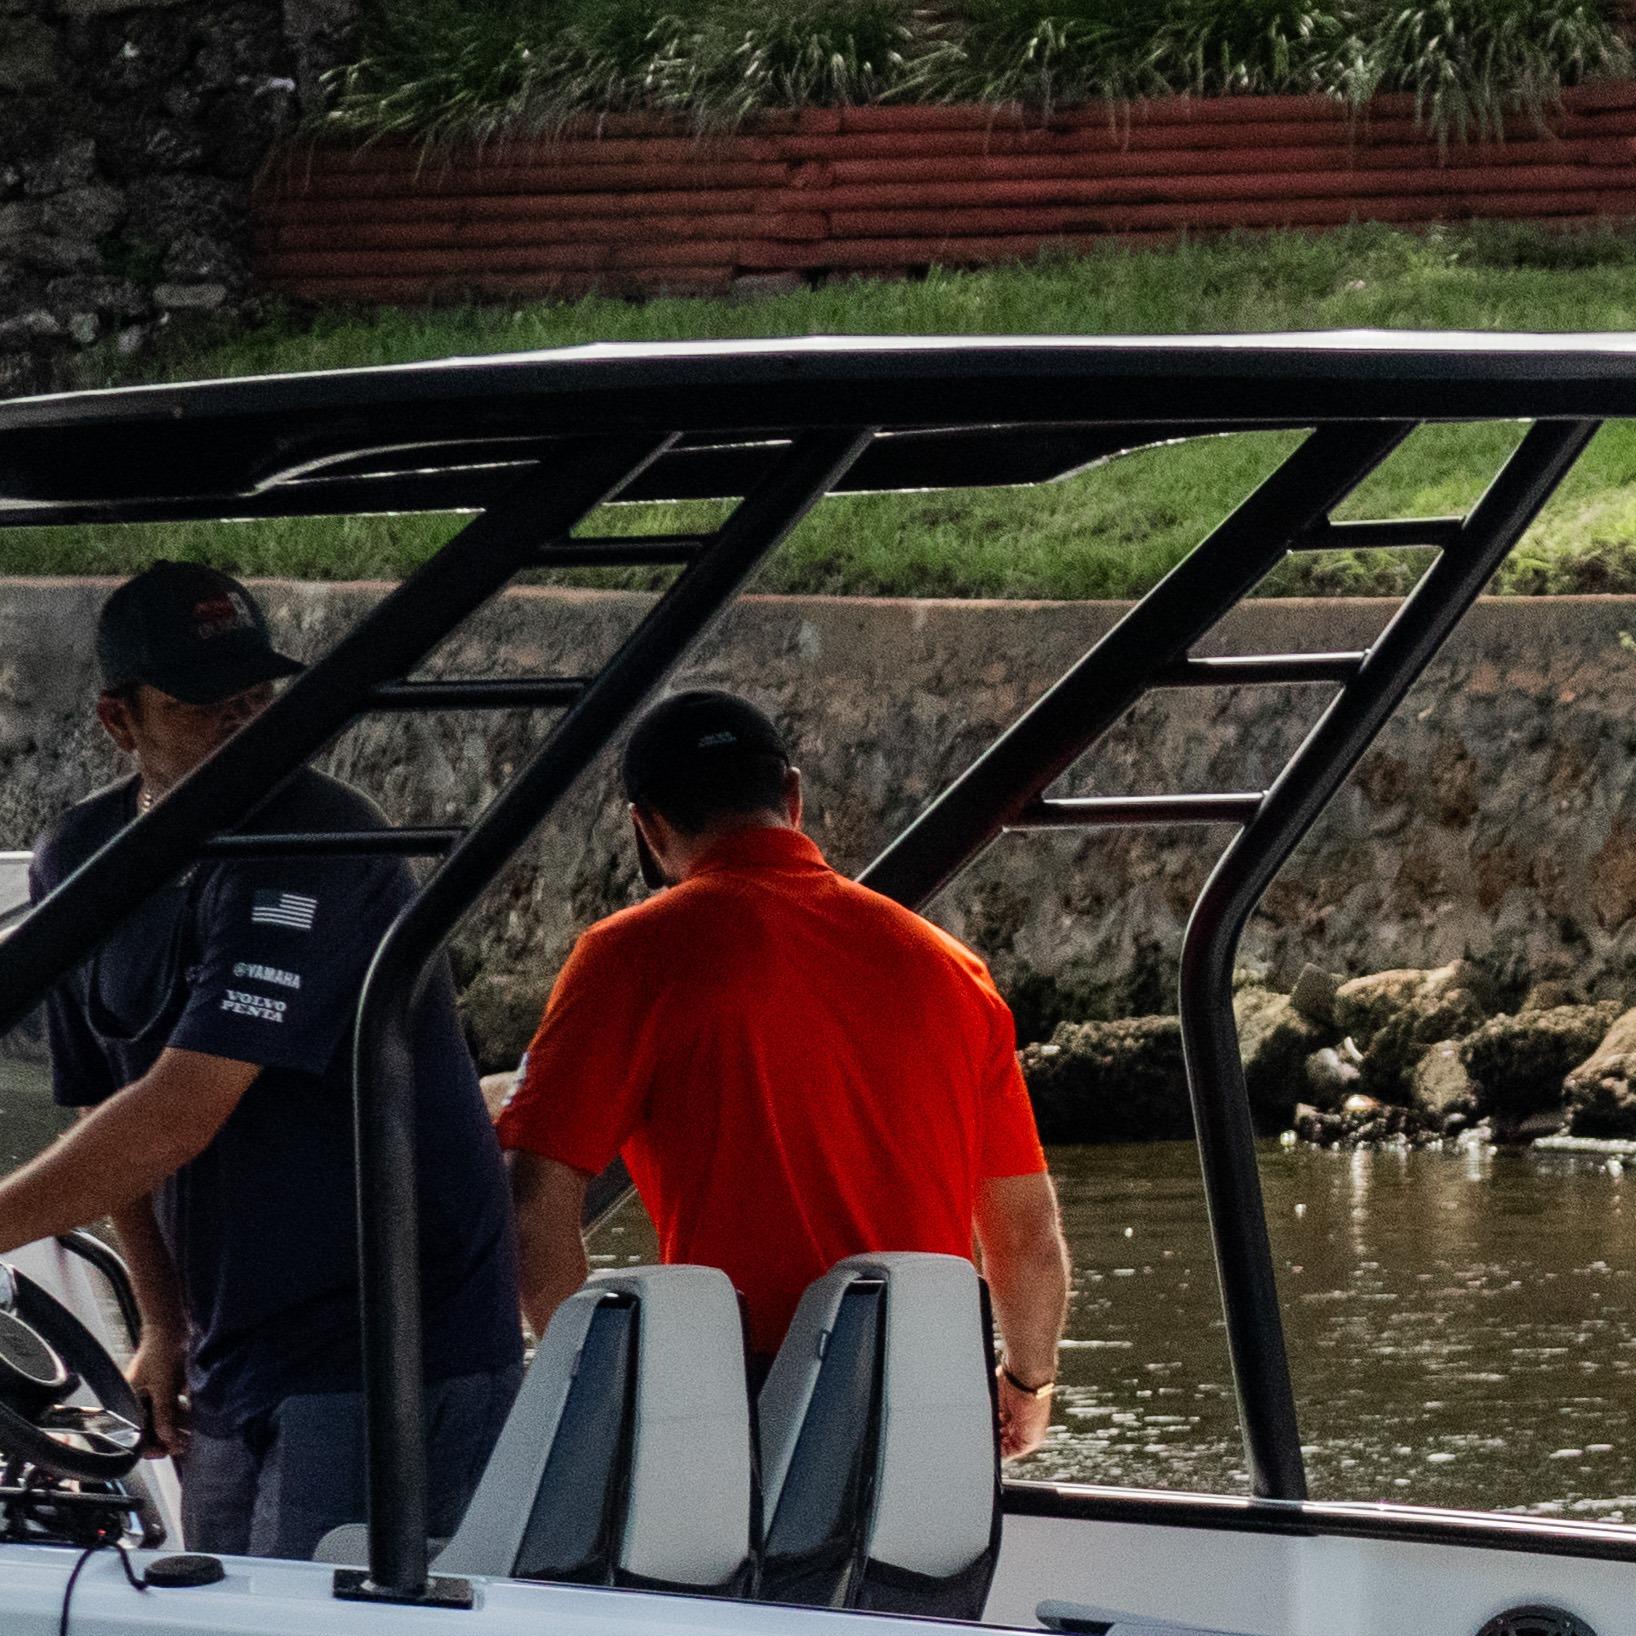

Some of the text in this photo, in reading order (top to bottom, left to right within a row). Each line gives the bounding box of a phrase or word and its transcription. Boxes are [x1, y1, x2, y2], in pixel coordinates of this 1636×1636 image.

[249, 963, 301, 989] YAMAHA
[220, 1000, 284, 1023] PENTA
[226, 989, 287, 1012] VOLVO
